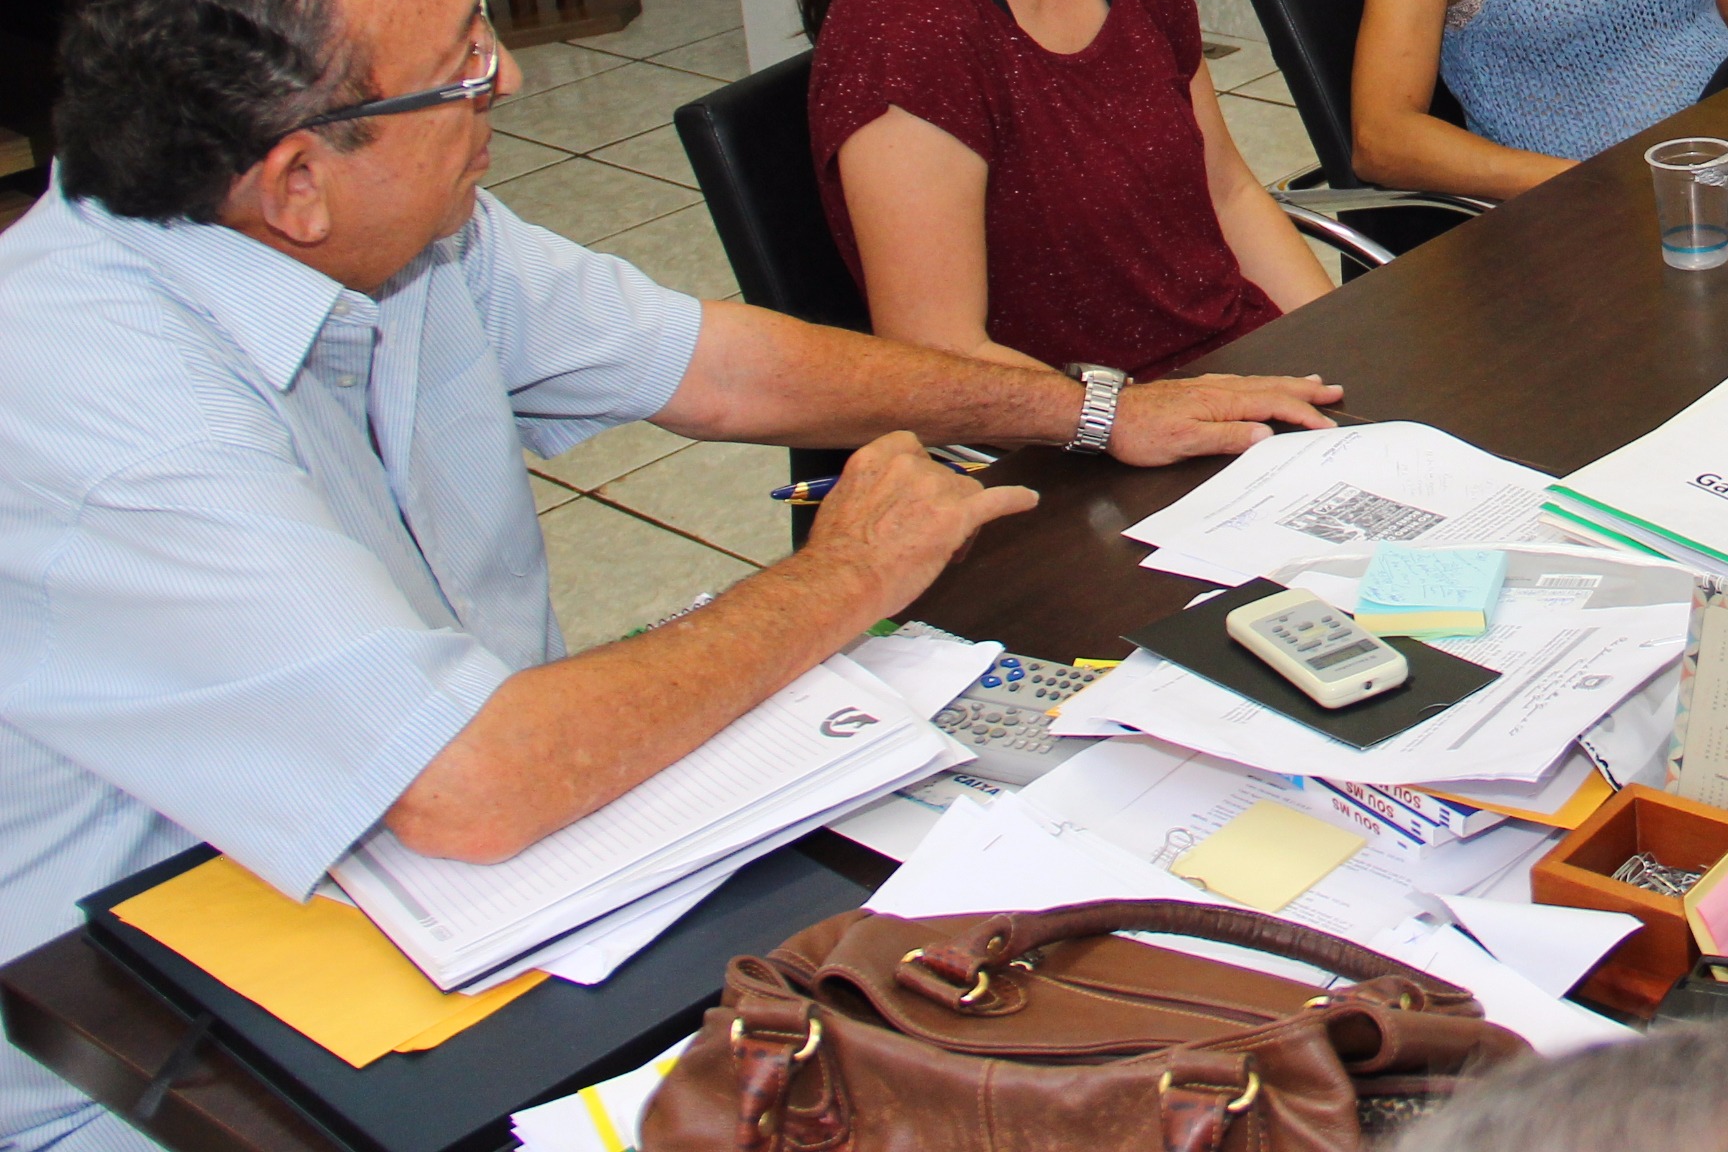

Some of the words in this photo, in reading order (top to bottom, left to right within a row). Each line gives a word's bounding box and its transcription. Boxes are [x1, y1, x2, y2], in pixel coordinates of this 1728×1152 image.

[954, 775, 1001, 795] CAIXA
[1346, 782, 1363, 799] MS
[1332, 798, 1350, 817] MS
[1368, 795, 1393, 818] SOU
[1354, 812, 1380, 835] SOU
